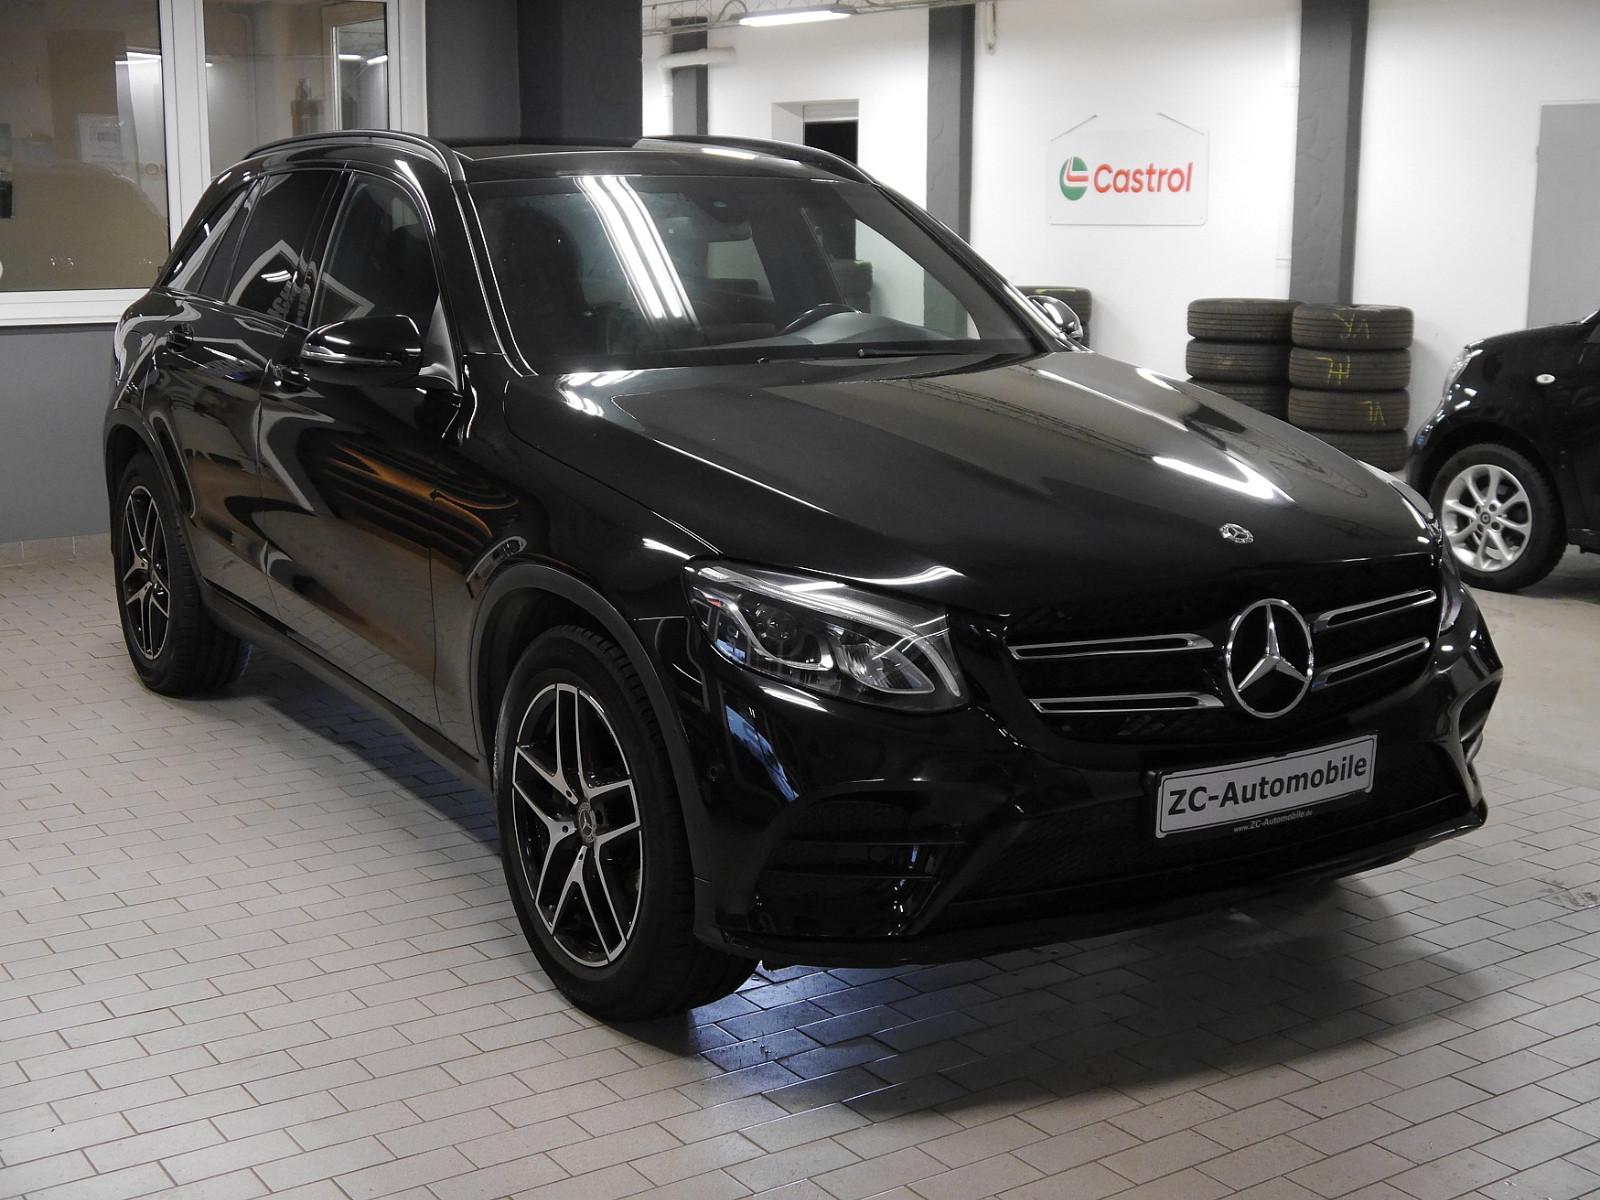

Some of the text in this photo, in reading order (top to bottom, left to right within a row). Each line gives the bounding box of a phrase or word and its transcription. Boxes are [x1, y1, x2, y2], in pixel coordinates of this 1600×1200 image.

[1093, 161, 1194, 194] Castrol
[1167, 754, 1368, 816] ZC-Automobile
[1233, 809, 1313, 833] www.ZC-Automobile.de
